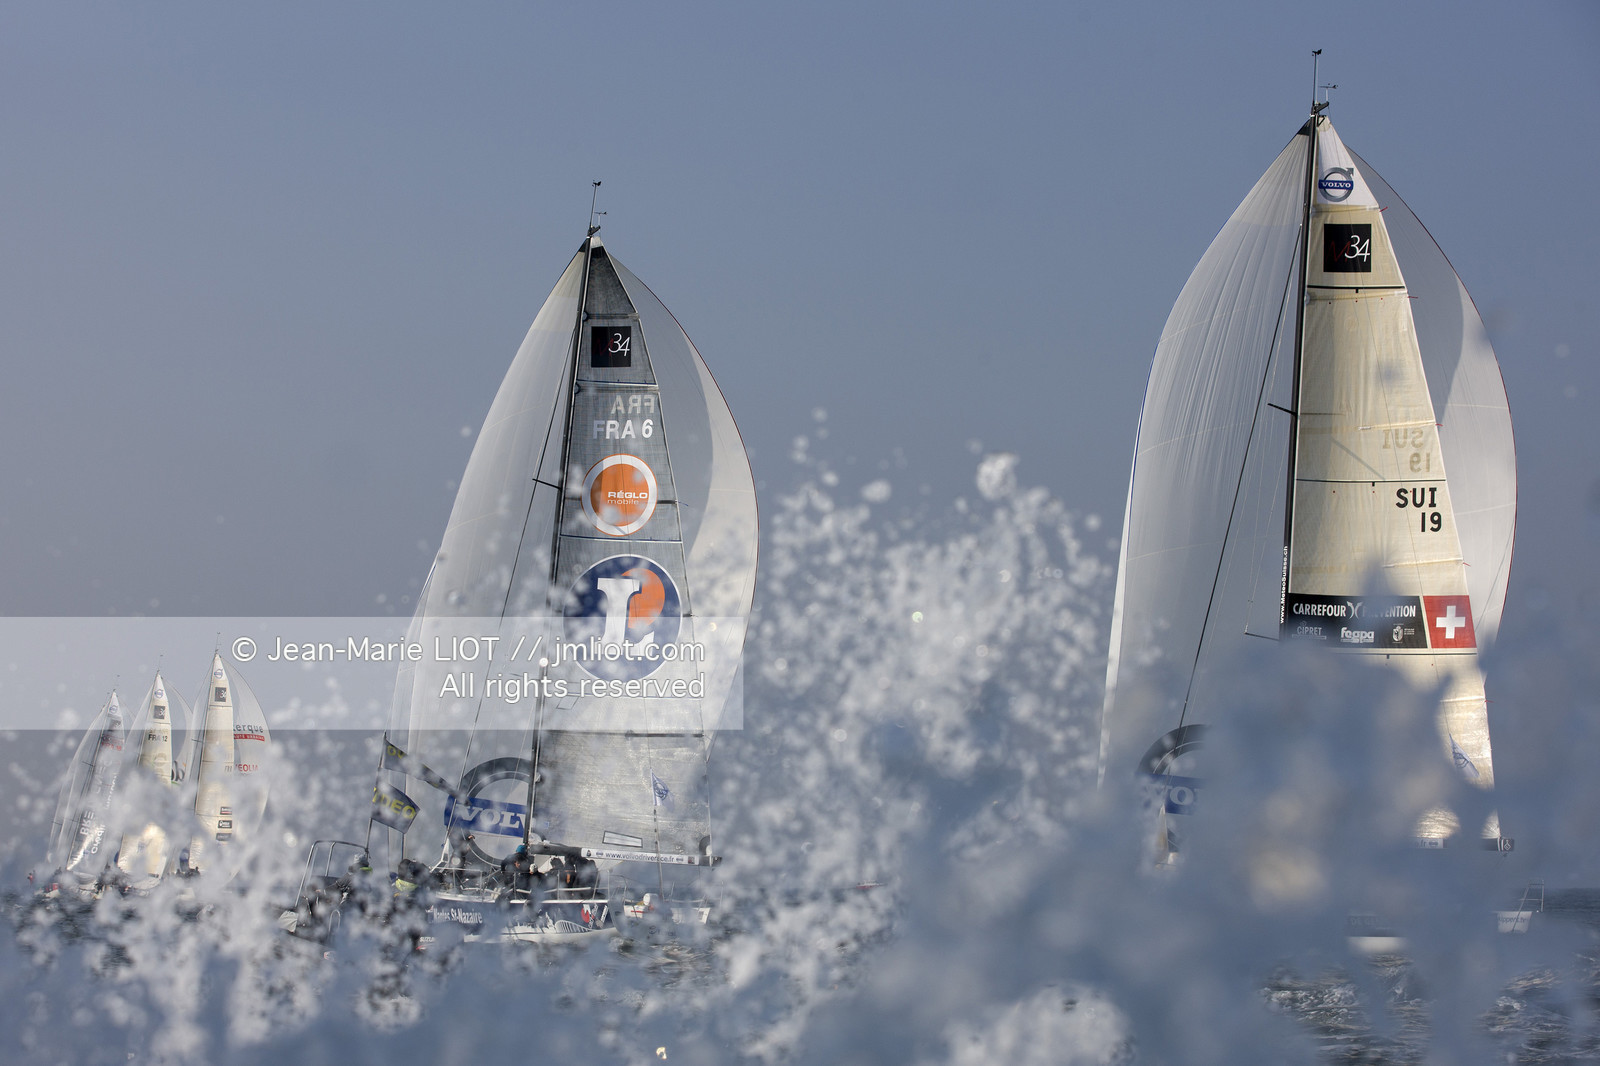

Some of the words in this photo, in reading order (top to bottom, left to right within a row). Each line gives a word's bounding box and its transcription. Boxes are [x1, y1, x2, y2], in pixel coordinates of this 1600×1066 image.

[1321, 181, 1352, 189] VOLVO
[592, 420, 636, 440] FRA
[641, 418, 654, 439] 6
[607, 489, 648, 499] RÉGLO
[1396, 487, 1437, 509] SUI
[1420, 511, 1442, 532] 19
[1292, 602, 1347, 617] CARREFOUR
